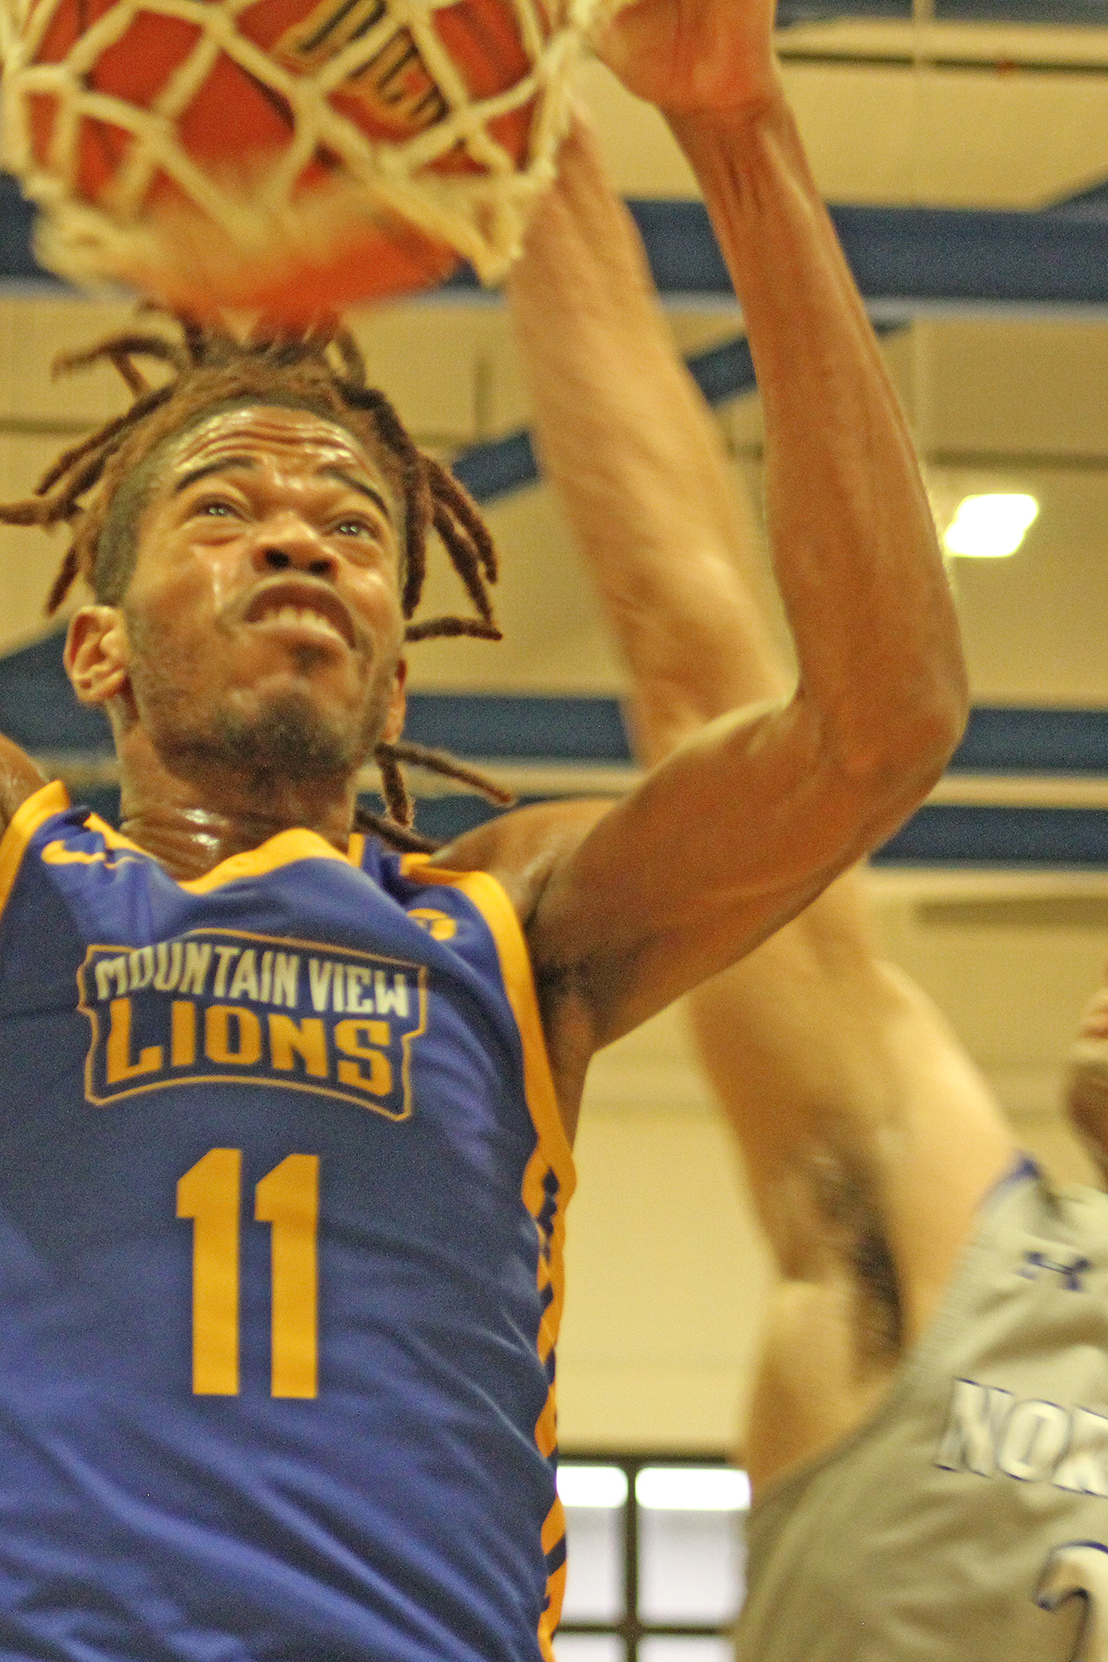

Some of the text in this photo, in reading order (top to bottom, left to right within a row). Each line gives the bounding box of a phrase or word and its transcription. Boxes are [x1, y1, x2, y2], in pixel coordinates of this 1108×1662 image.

[95, 942, 408, 1018] MOUNTAIN VIEW
[106, 998, 392, 1096] LIONS
[176, 1147, 319, 1399] 11
